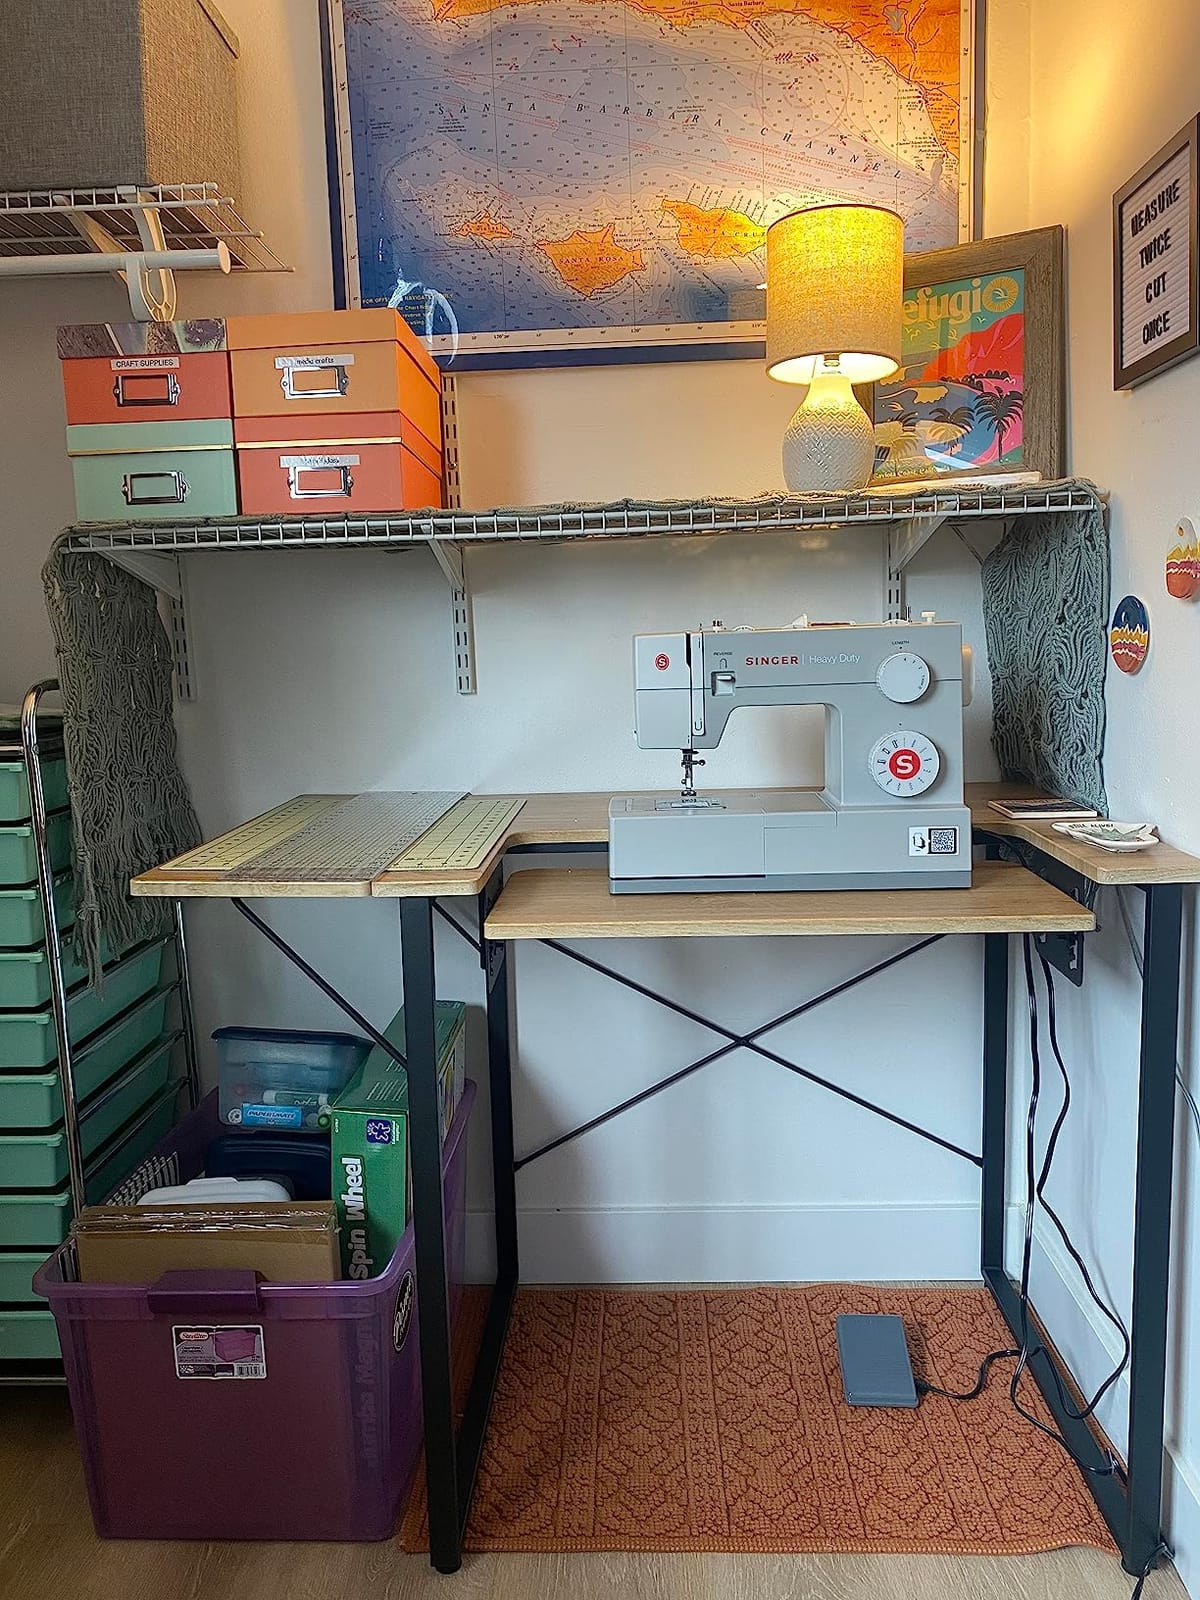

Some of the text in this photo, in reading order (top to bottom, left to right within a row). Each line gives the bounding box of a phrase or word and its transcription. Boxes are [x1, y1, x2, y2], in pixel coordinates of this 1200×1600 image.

[438, 102, 537, 115] SANTA
[576, 103, 723, 127] BARBARA
[760, 127, 902, 179] CHANNEL
[1130, 178, 1180, 238] MEASURE
[560, 257, 590, 265] SANTA
[1139, 228, 1172, 270] TWICE
[1145, 271, 1168, 304] CUT
[1143, 310, 1170, 345] ONCE
[116, 358, 174, 369] CRAFT SUPPLIES
[745, 653, 861, 667] SINGER Heavy Duty
[341, 1157, 374, 1280] Spin Wheel
